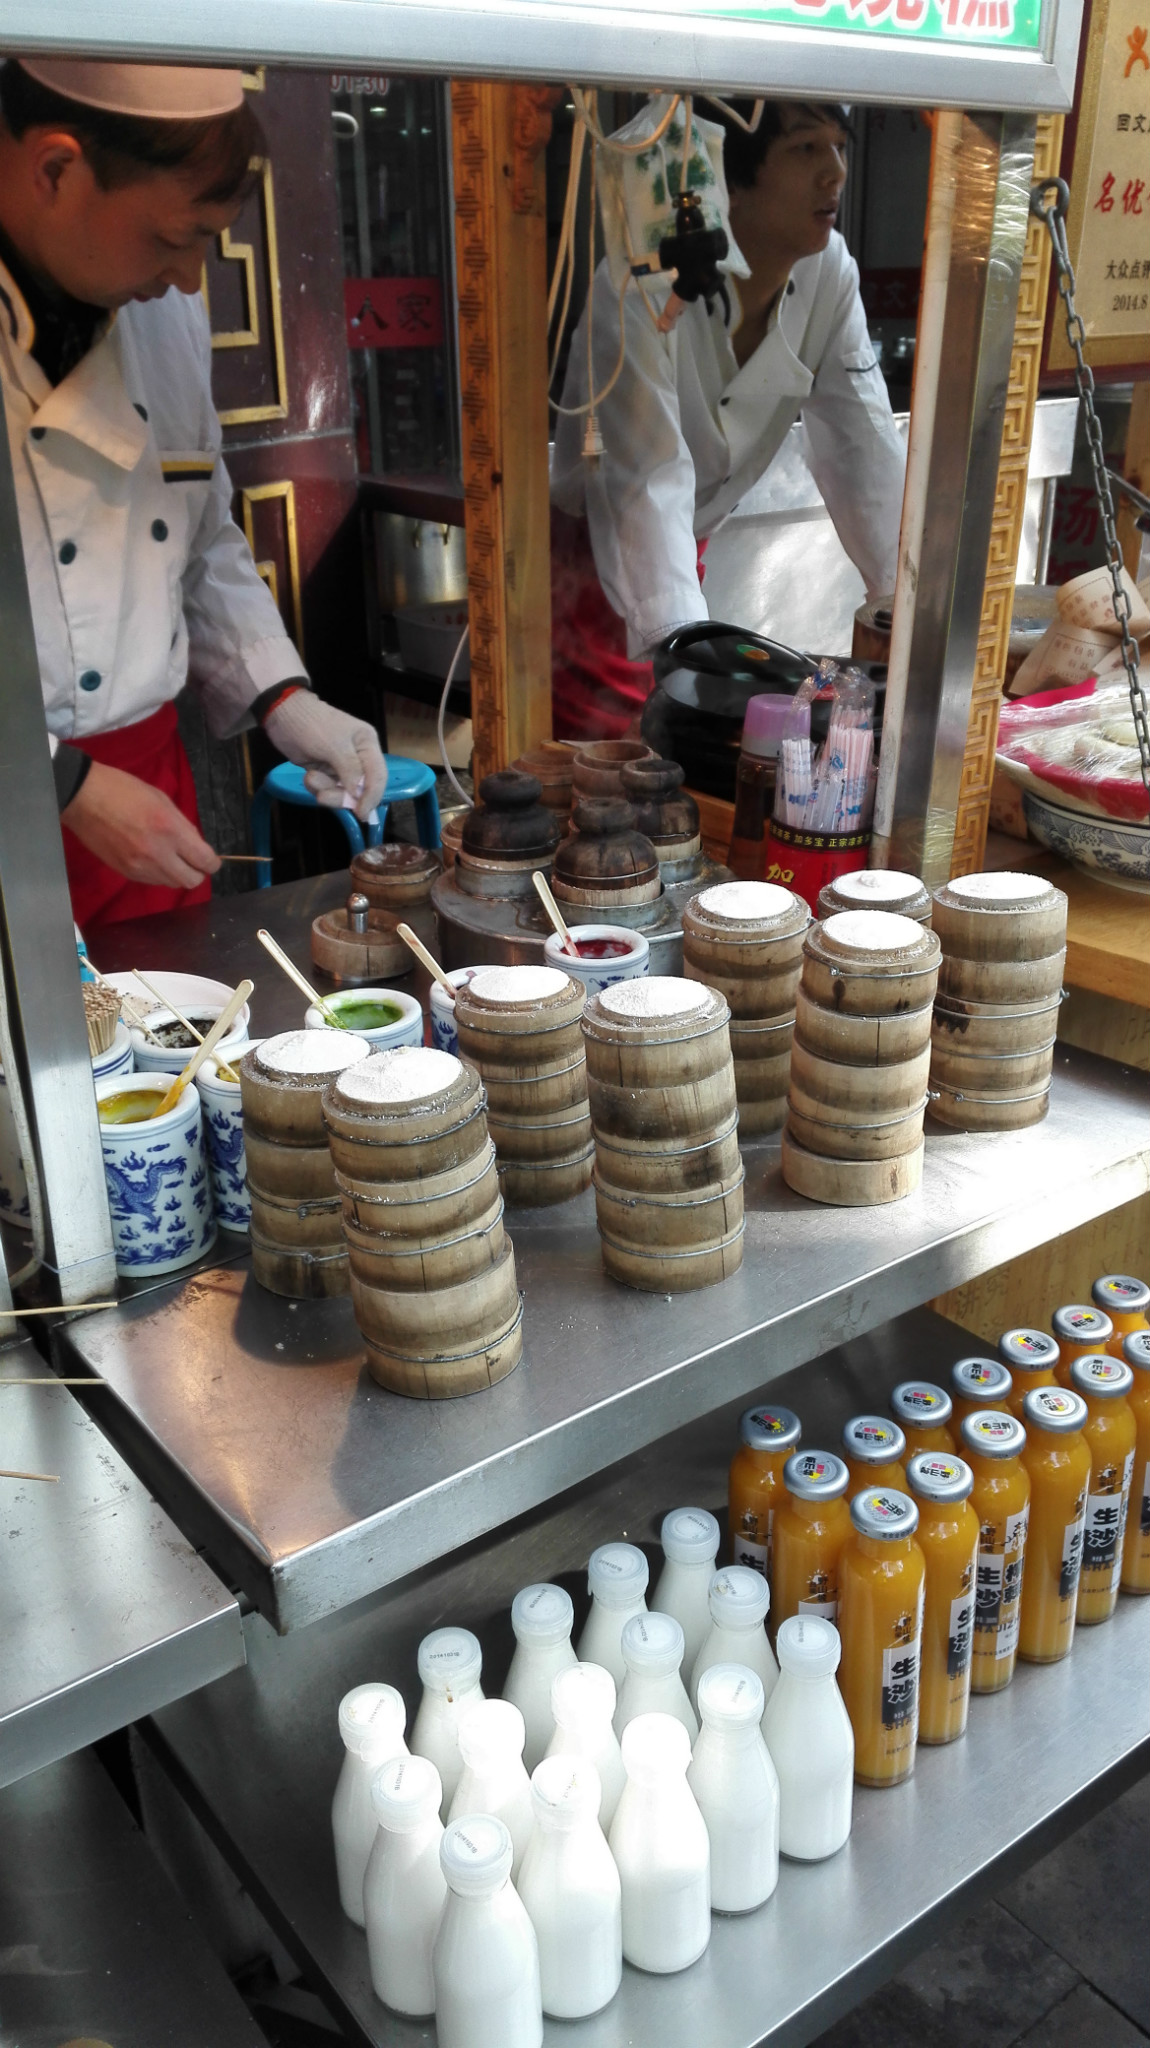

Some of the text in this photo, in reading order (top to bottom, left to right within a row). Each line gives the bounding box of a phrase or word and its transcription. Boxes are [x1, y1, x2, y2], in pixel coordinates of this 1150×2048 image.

[1117, 113, 1150, 134] 回文
[1094, 171, 1150, 216] 名优
[765, 862, 795, 884] 加
[891, 1655, 917, 1681] 生
